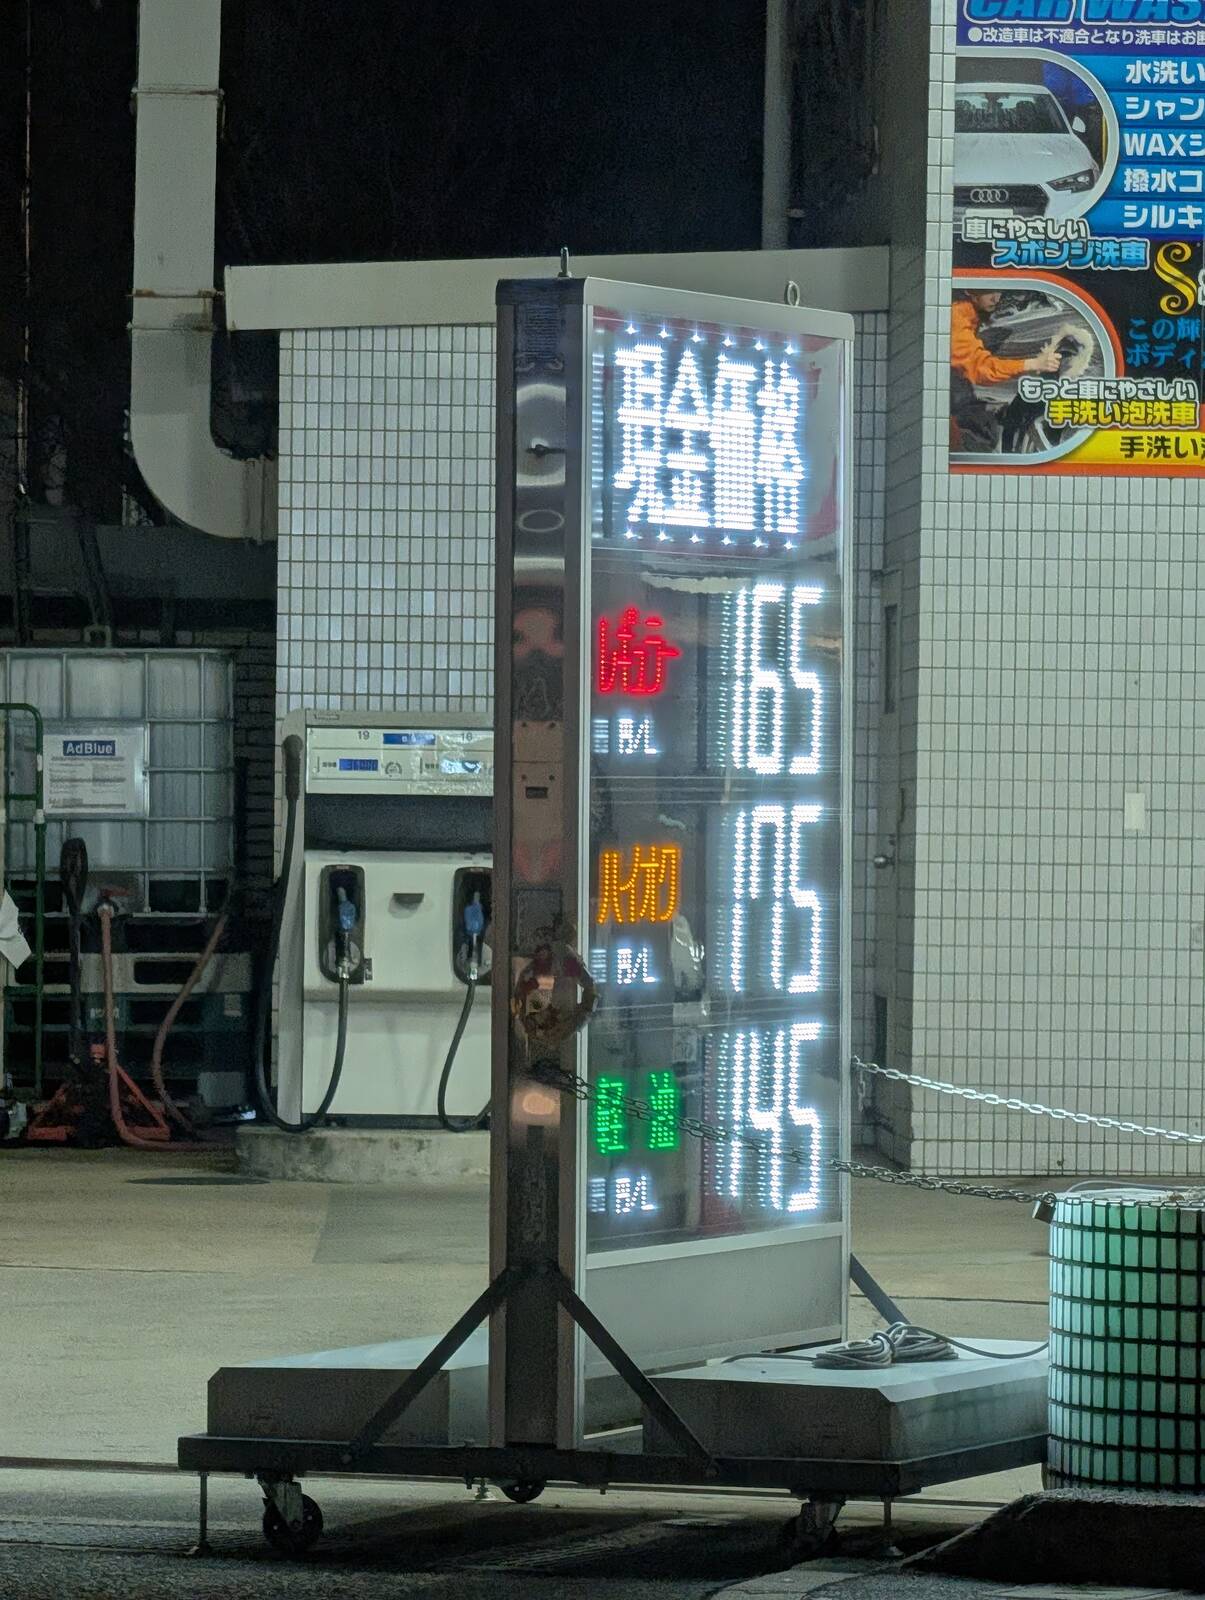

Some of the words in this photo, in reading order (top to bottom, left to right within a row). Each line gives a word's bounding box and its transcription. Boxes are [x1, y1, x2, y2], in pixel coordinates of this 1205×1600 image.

[1087, 0, 1205, 20] WAS
[1126, 60, 1205, 84] 水洗い
[1126, 97, 1205, 120] シャン
[1123, 168, 1203, 192] 撥水コ
[965, 218, 1086, 239] 車にやさしい
[1123, 205, 1203, 229] シルキ
[994, 240, 1147, 267] スポンジ洗車
[1126, 343, 1205, 368] ボディ
[1022, 379, 1195, 400] もっと車にやさしい
[1049, 401, 1196, 425] 手洗い泡洗車
[613, 343, 805, 534] 現金価格
[1120, 435, 1205, 459] 手洗い
[731, 583, 825, 775] 165
[66, 742, 113, 755] AdBlue
[597, 846, 680, 923] ハイオク
[730, 804, 824, 994] 175
[729, 1022, 822, 1212] 145
